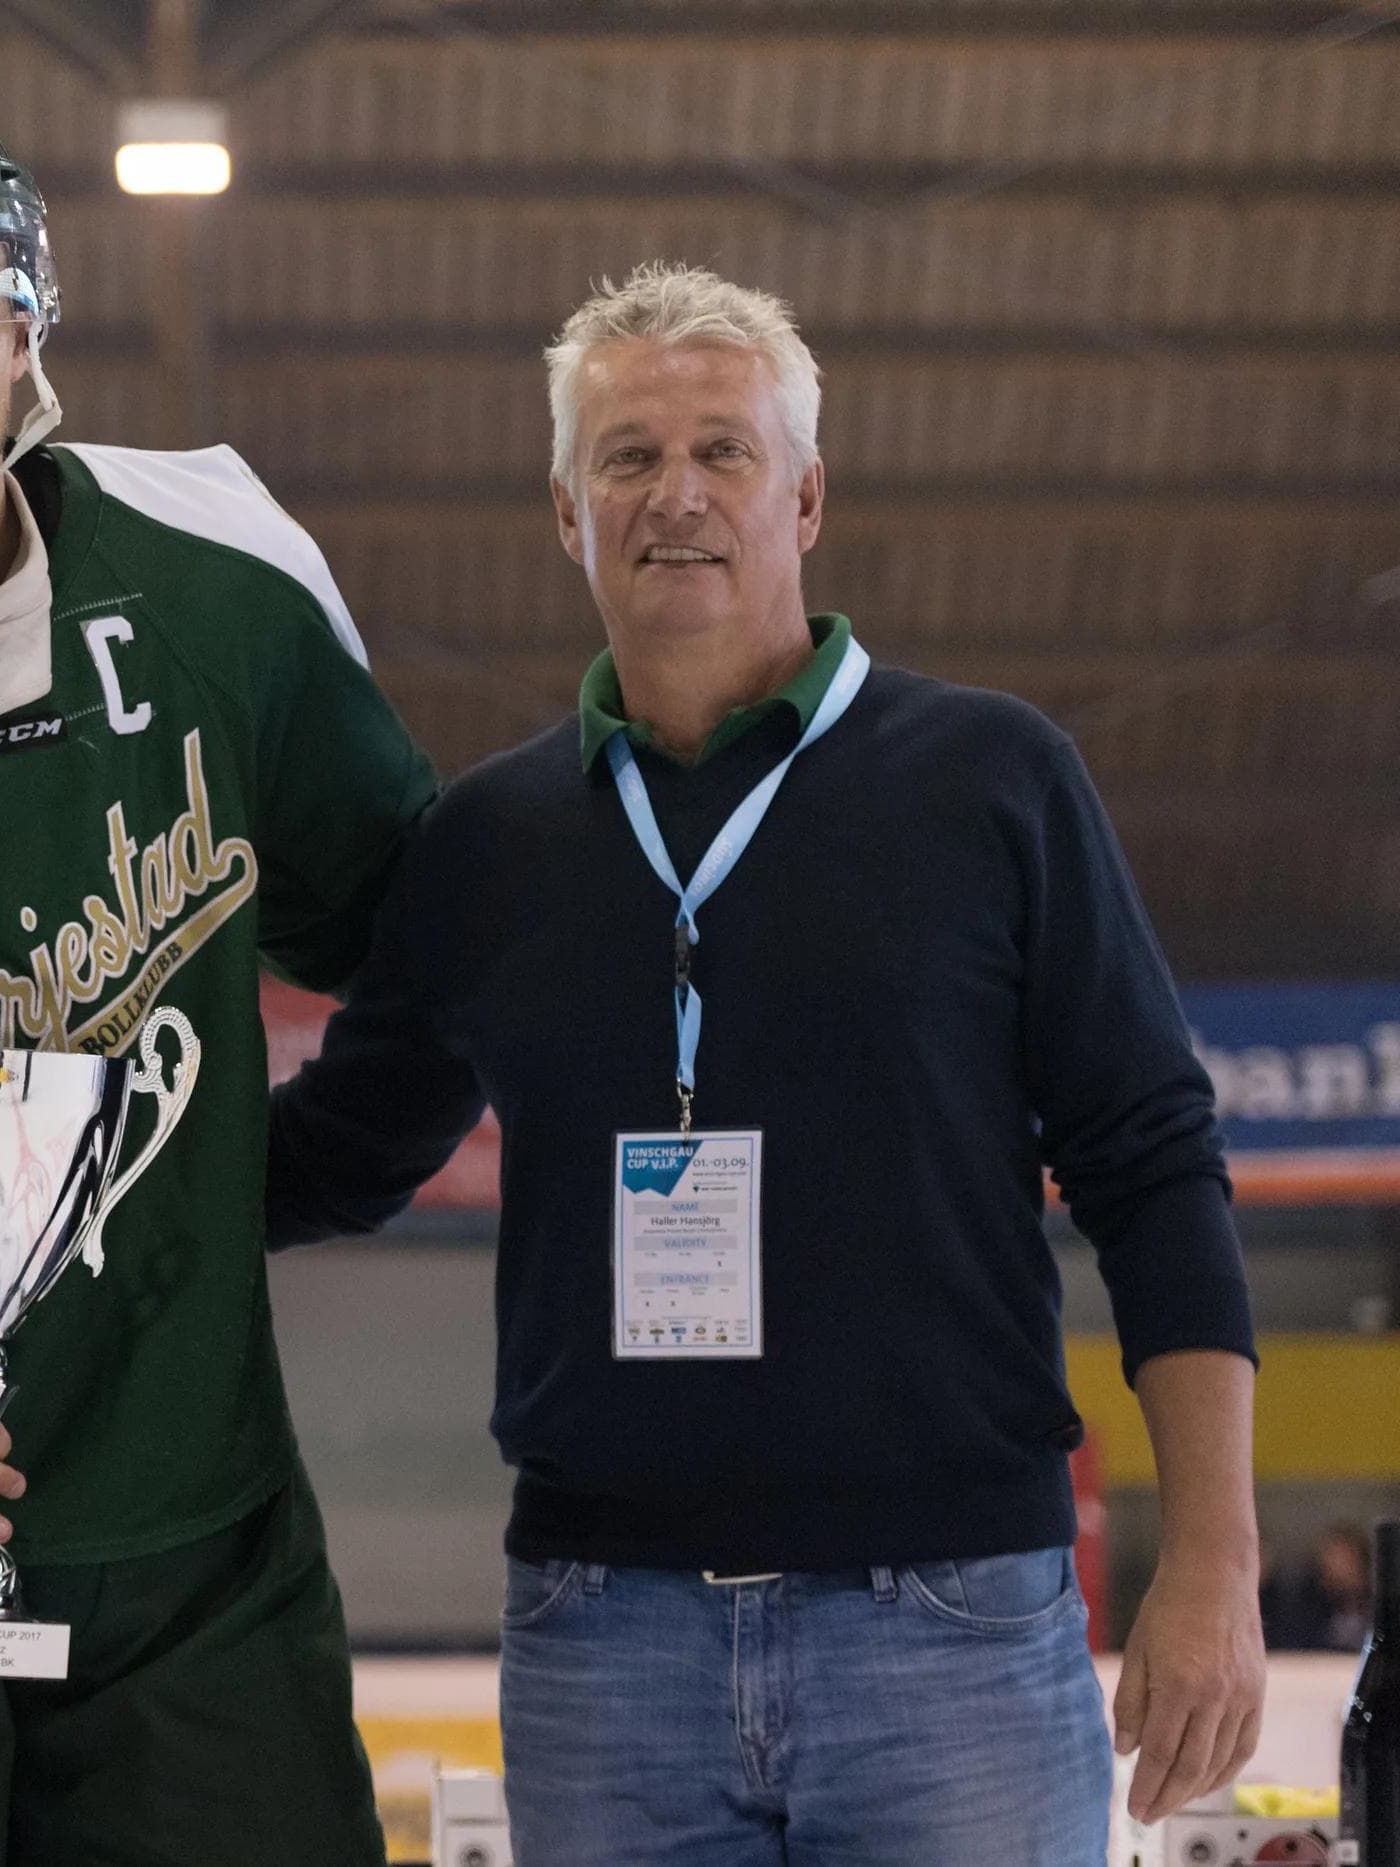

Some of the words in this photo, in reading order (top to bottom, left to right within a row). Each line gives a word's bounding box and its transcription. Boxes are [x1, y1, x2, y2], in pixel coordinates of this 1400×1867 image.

[85, 615, 152, 735] C
[78, 942, 184, 1055] BOLLKLUBB
[627, 1146, 694, 1158] VINSCHGAU
[627, 1159, 649, 1170] CUP
[650, 1158, 679, 1170] V.I.P.
[672, 1202, 699, 1212] NAME
[651, 1216, 678, 1226] Haller
[680, 1215, 721, 1228] Hansjörg
[664, 1239, 708, 1249] VALIDITY
[660, 1273, 710, 1285] ENTRANCE
[19, 1631, 43, 1641] 2017
[1, 1657, 16, 1667] BK
